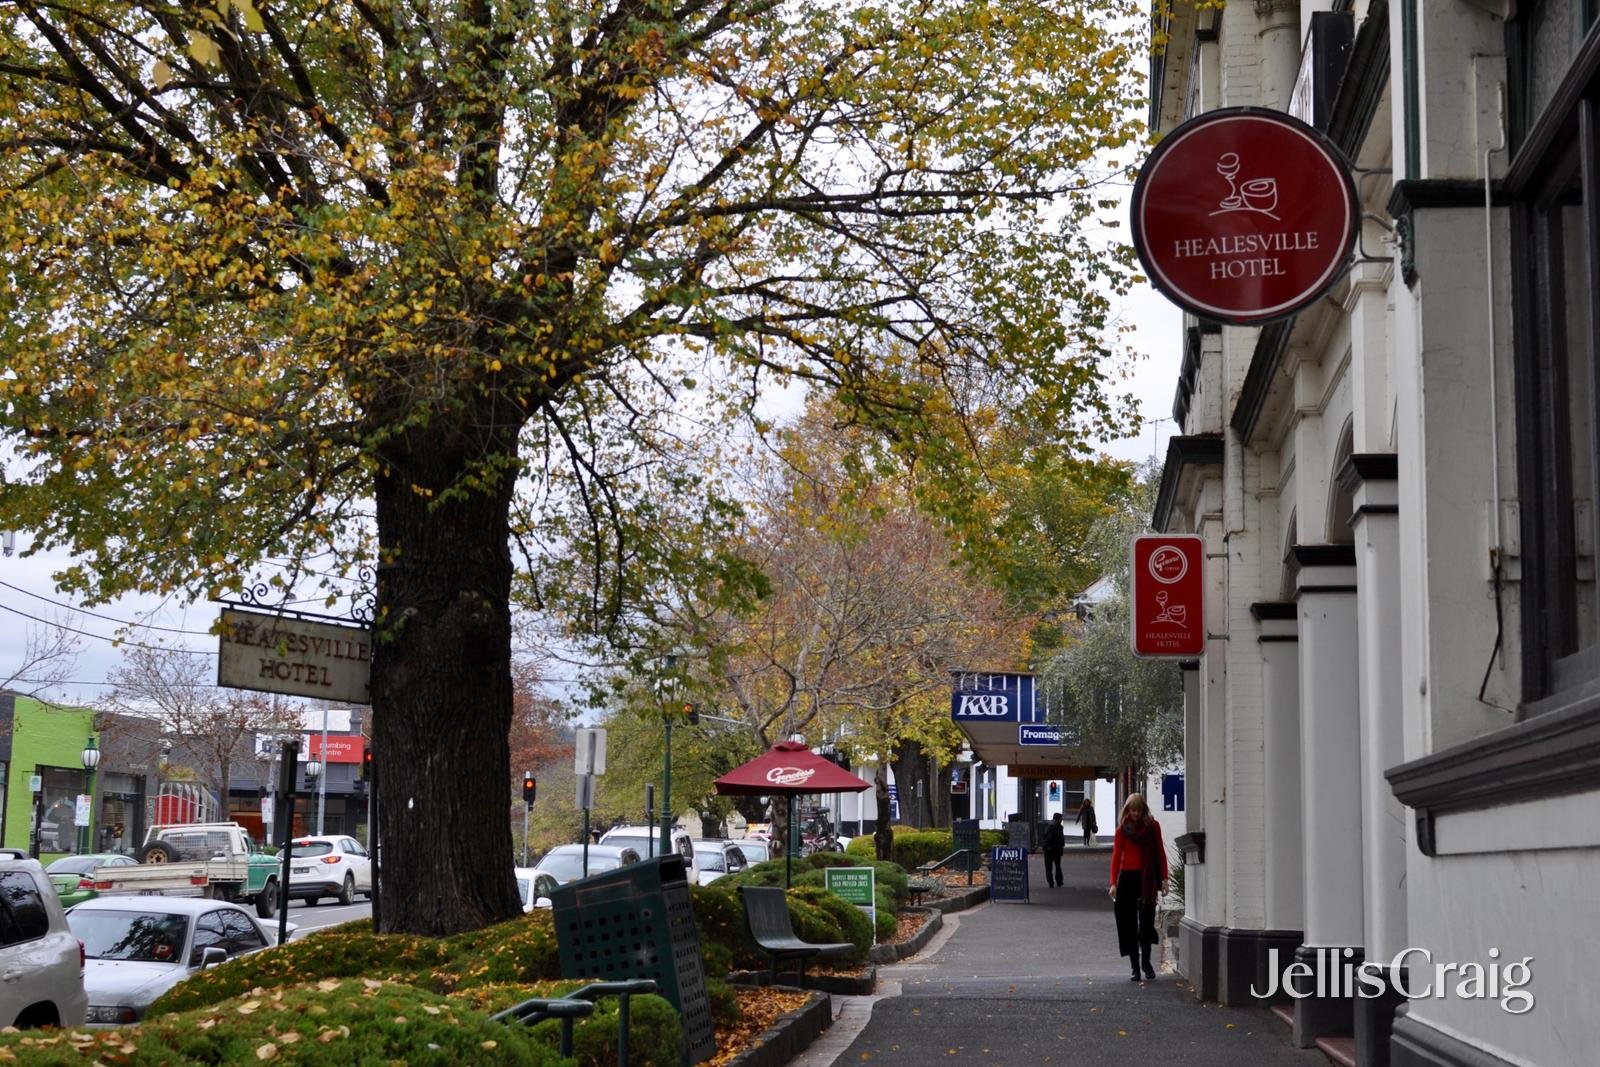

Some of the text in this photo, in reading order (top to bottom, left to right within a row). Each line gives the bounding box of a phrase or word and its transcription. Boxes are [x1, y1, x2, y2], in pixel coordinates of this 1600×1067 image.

[1174, 231, 1319, 257] HEALESVILLE
[1210, 258, 1286, 280] HOTEL
[1156, 640, 1181, 648] HOTEL
[259, 658, 333, 687] HOTEL
[956, 694, 1009, 716] K&B
